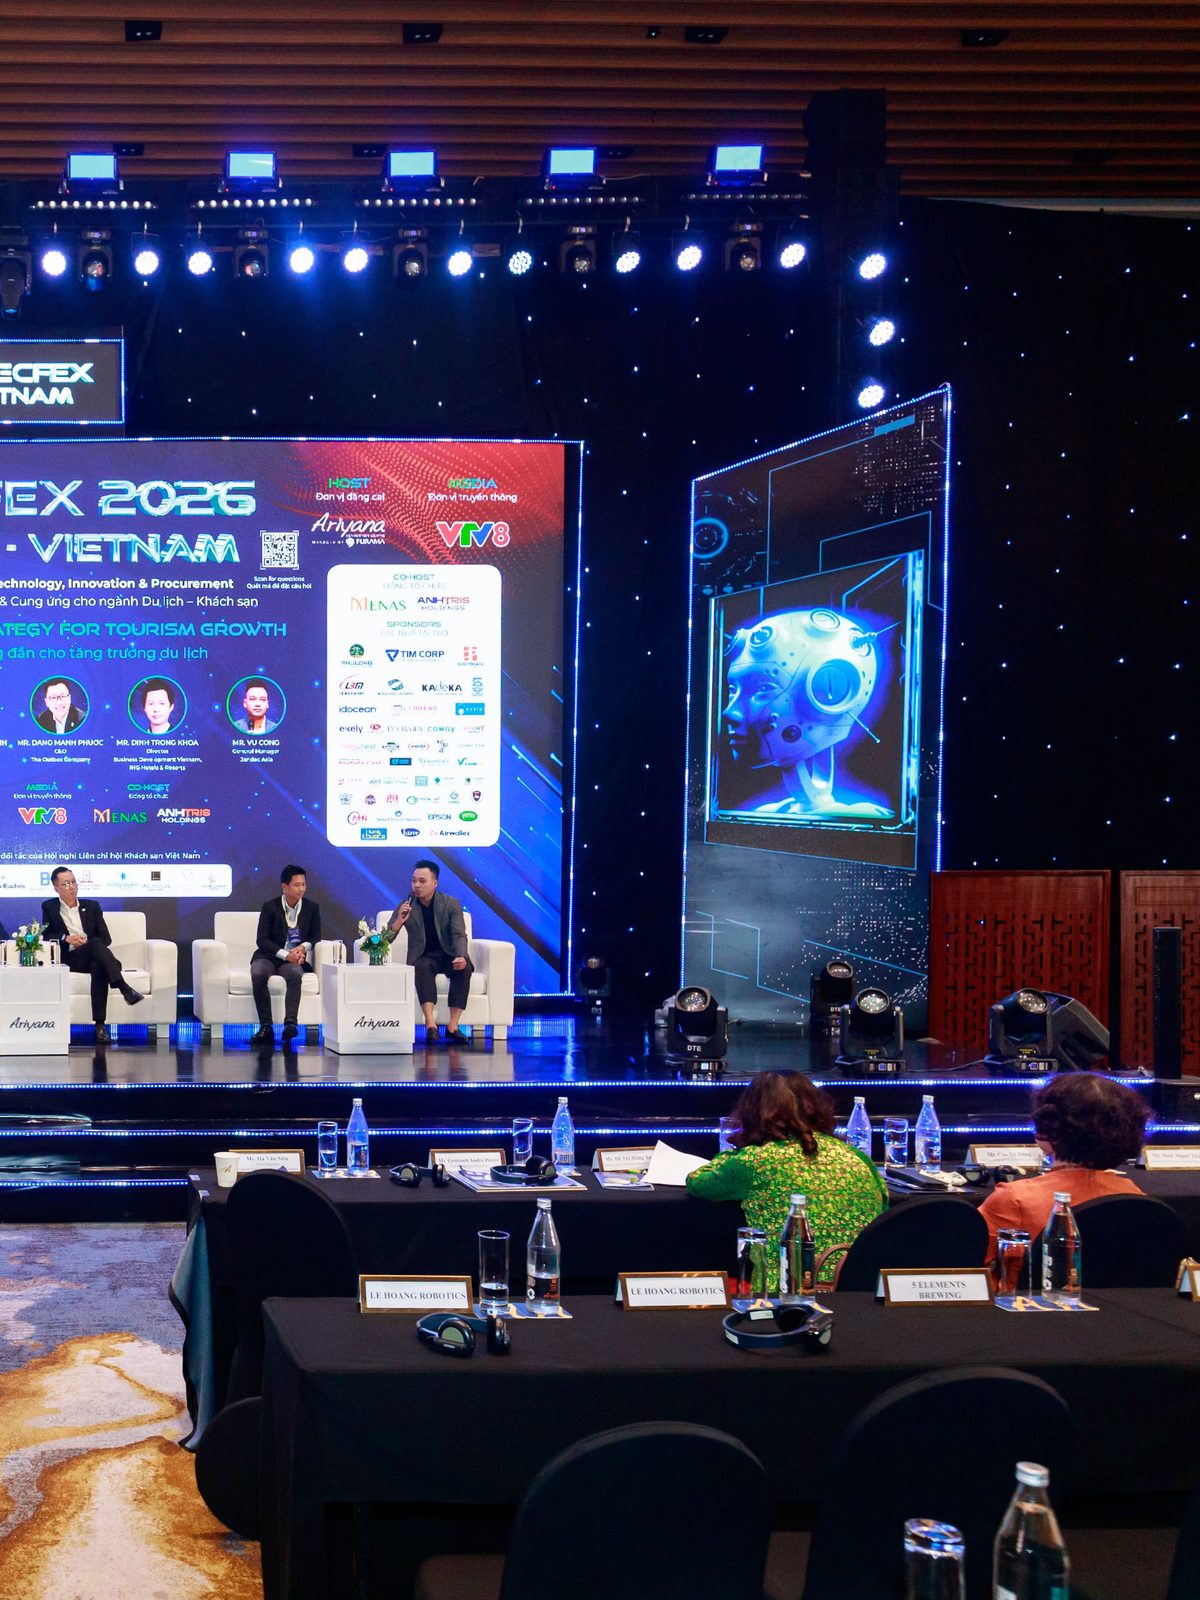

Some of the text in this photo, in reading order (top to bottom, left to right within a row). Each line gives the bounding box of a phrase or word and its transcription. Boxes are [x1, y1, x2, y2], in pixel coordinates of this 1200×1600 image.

[328, 478, 371, 489] HOST
[449, 478, 498, 489] MEDIA
[98, 480, 256, 516] 2026
[311, 512, 386, 537] Ariyana
[436, 521, 510, 547] VTV8
[27, 533, 240, 563] VIETNAM
[68, 578, 137, 589] Innovation
[139, 579, 149, 589] &
[151, 578, 234, 590] Procurement
[0, 596, 8, 606] &
[11, 596, 43, 609] Cung
[46, 594, 71, 609] ứng
[73, 596, 96, 606] cho
[99, 595, 139, 609] ngành
[142, 596, 159, 606] Du
[163, 595, 184, 608] lịch
[196, 595, 234, 606] Khách
[237, 597, 259, 609] sạn
[351, 597, 406, 611] MENAS
[59, 623, 100, 636] FOR
[105, 623, 196, 636] TOURISM
[200, 623, 287, 636] GROWTH
[39, 648, 66, 659] cho
[69, 648, 102, 662] tăng
[160, 648, 180, 659] du
[184, 648, 208, 661] lịch
[401, 650, 444, 658] TIM CORP
[339, 705, 376, 713] idocean
[339, 725, 363, 734] exely
[18, 807, 67, 825] VTV8
[93, 808, 147, 823] MENAS
[157, 808, 210, 816] ANHTRIS
[182, 852, 200, 860] Nam
[10, 1016, 55, 1031] Ariyana
[354, 1015, 400, 1030] Ariyana
[918, 1280, 967, 1289] ELEMENTS
[370, 1291, 466, 1300] LE HOANG ROBOTICS
[631, 1287, 725, 1296] LE HOANG ROBOTICS
[919, 1292, 961, 1300] BREWING
